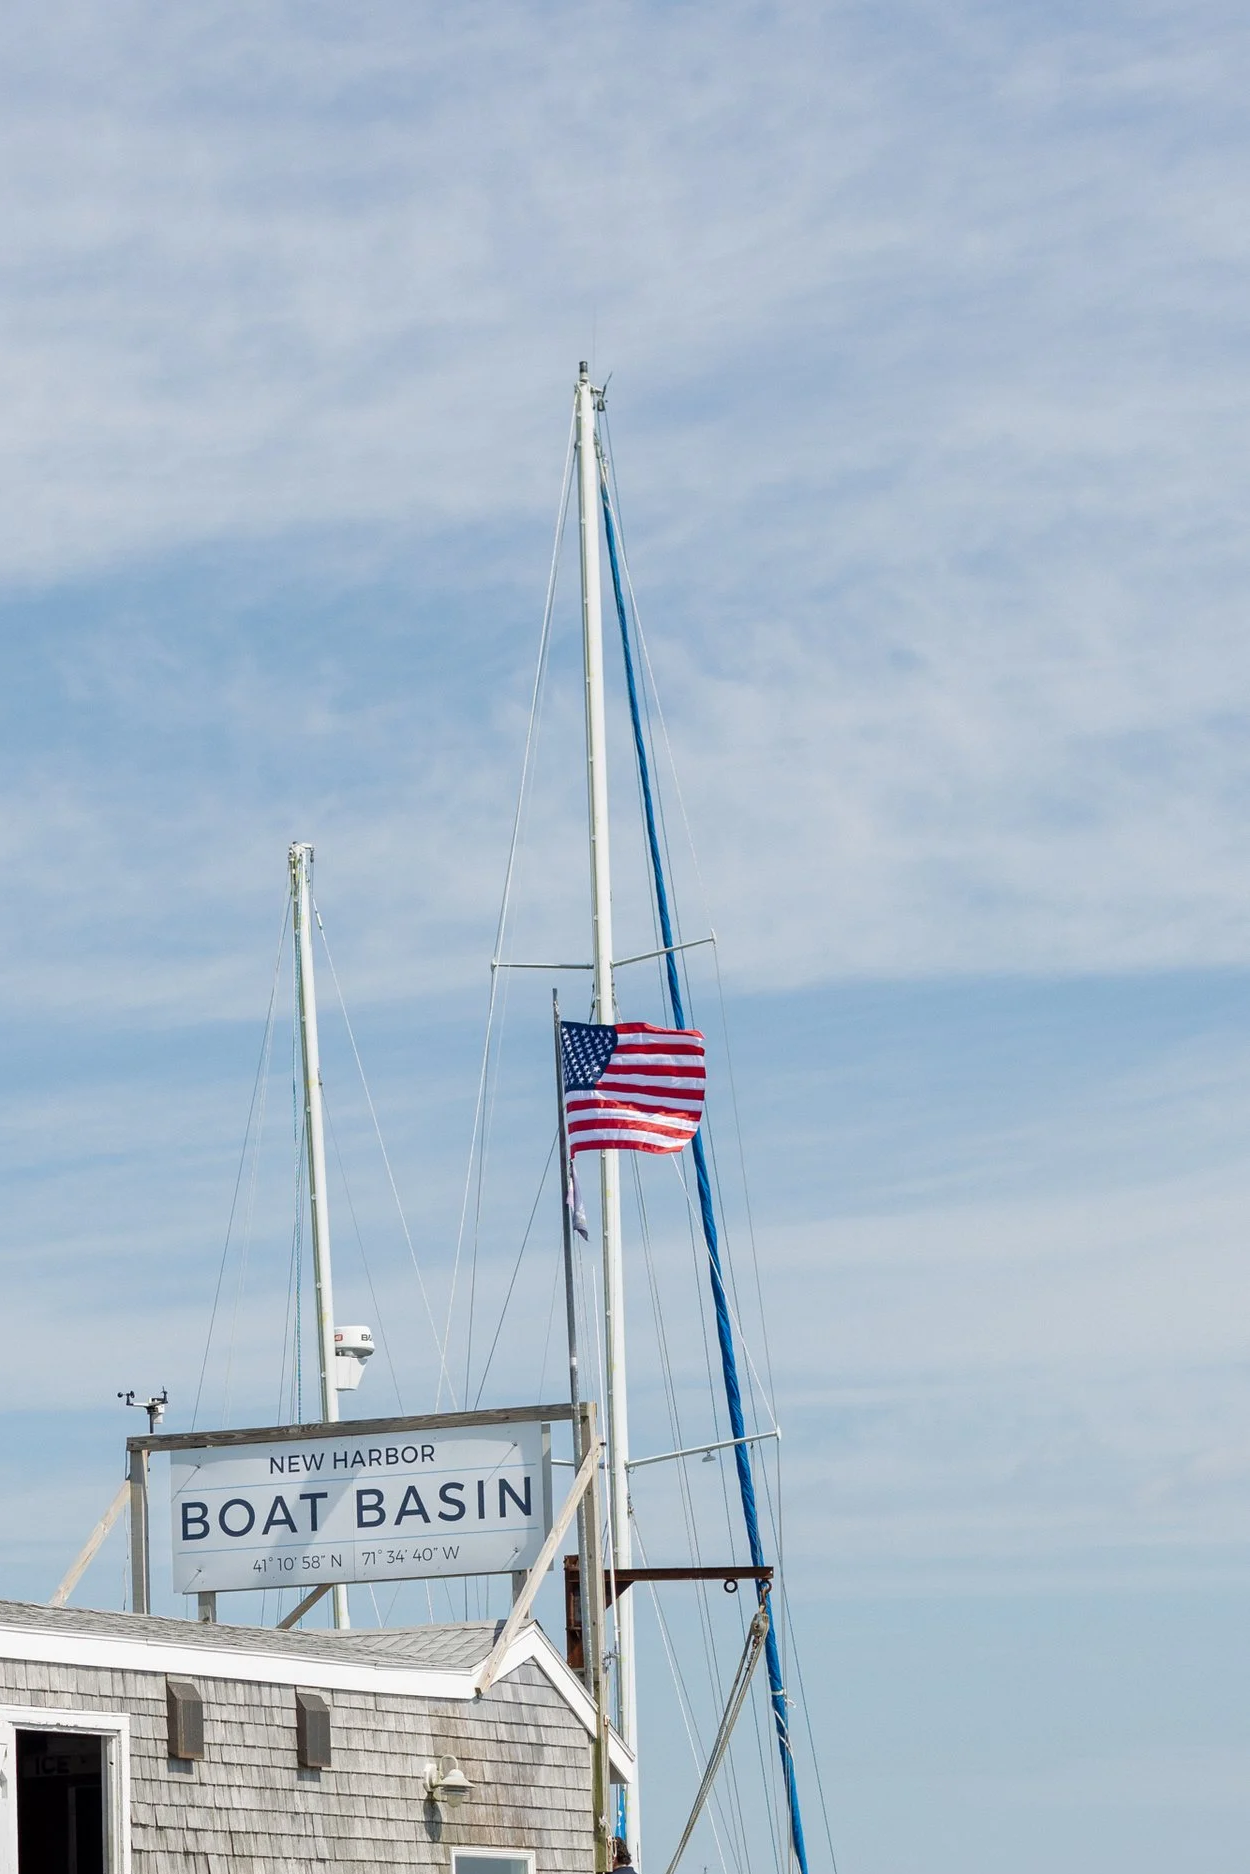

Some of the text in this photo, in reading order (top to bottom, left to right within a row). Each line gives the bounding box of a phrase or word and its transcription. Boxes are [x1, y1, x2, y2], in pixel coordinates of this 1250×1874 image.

[269, 1444, 436, 1474] NEW HARBOR
[181, 1476, 532, 1541] BOAT BASIN
[330, 1553, 342, 1568] N
[442, 1545, 460, 1560] W
[34, 1754, 70, 1775] ICE
